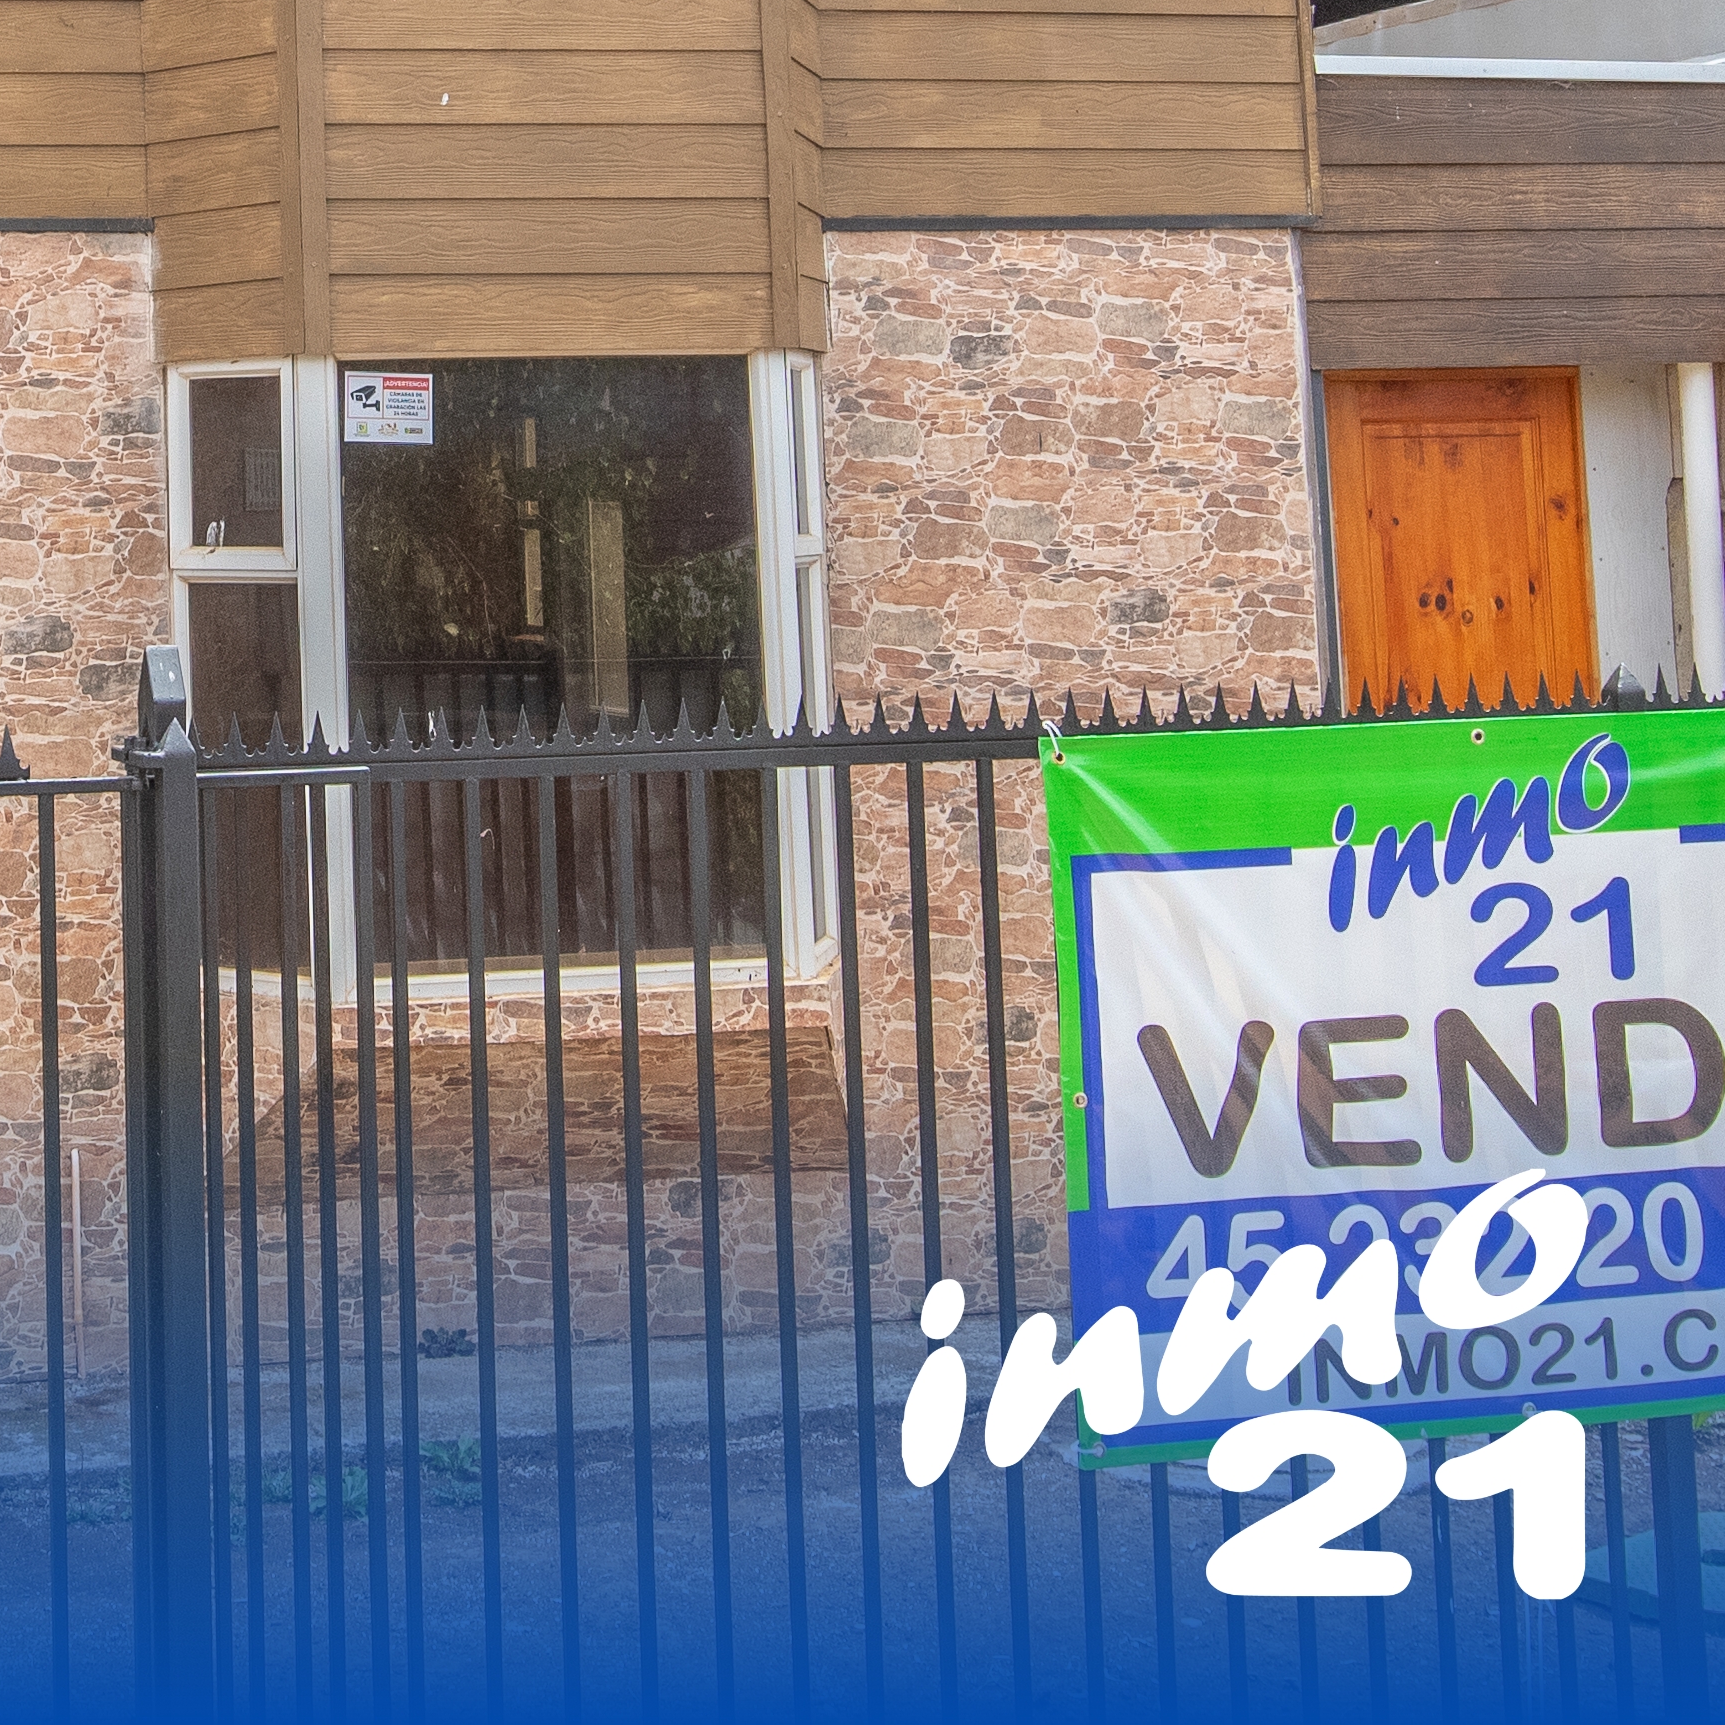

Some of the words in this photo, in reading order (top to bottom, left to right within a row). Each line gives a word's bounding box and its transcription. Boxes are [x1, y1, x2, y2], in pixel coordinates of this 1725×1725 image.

[1470, 876, 1636, 987] 21
[1137, 997, 1725, 1179] VEND
[1145, 1209, 1287, 1311] 45
